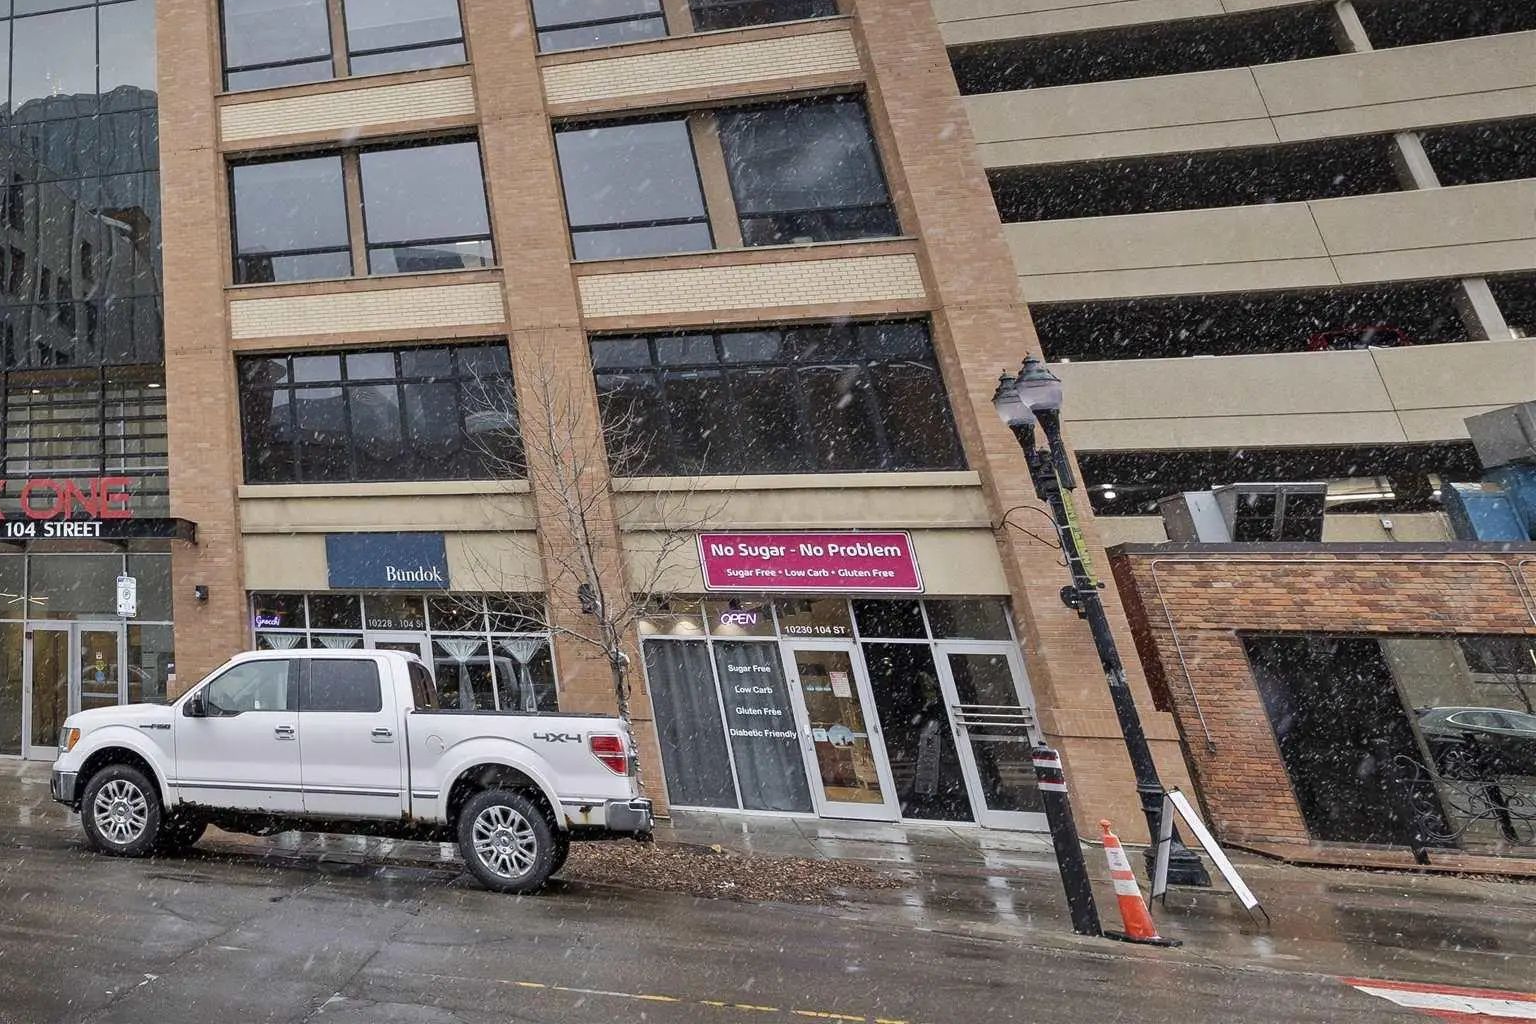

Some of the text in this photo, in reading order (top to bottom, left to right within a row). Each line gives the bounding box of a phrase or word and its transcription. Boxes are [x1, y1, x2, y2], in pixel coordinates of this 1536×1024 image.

[21, 477, 133, 519] ONE
[5, 522, 36, 537] 104
[44, 521, 103, 537] STREET
[711, 543, 734, 557] No
[739, 543, 785, 560] Sugar
[800, 543, 824, 557] No
[828, 542, 902, 557] Problem
[385, 565, 443, 582] Bundok
[726, 568, 895, 578] Sugar Free Low Carb Gluten Free
[368, 619, 392, 628] 10228
[399, 620, 414, 628] 104
[720, 613, 757, 625] OPEN
[784, 626, 846, 634] 10230 104 ST
[727, 664, 771, 674] Sugar Free
[734, 685, 773, 694] Low Carb
[735, 707, 782, 716] Gluten Free
[729, 728, 798, 740] Diabetic Friendly
